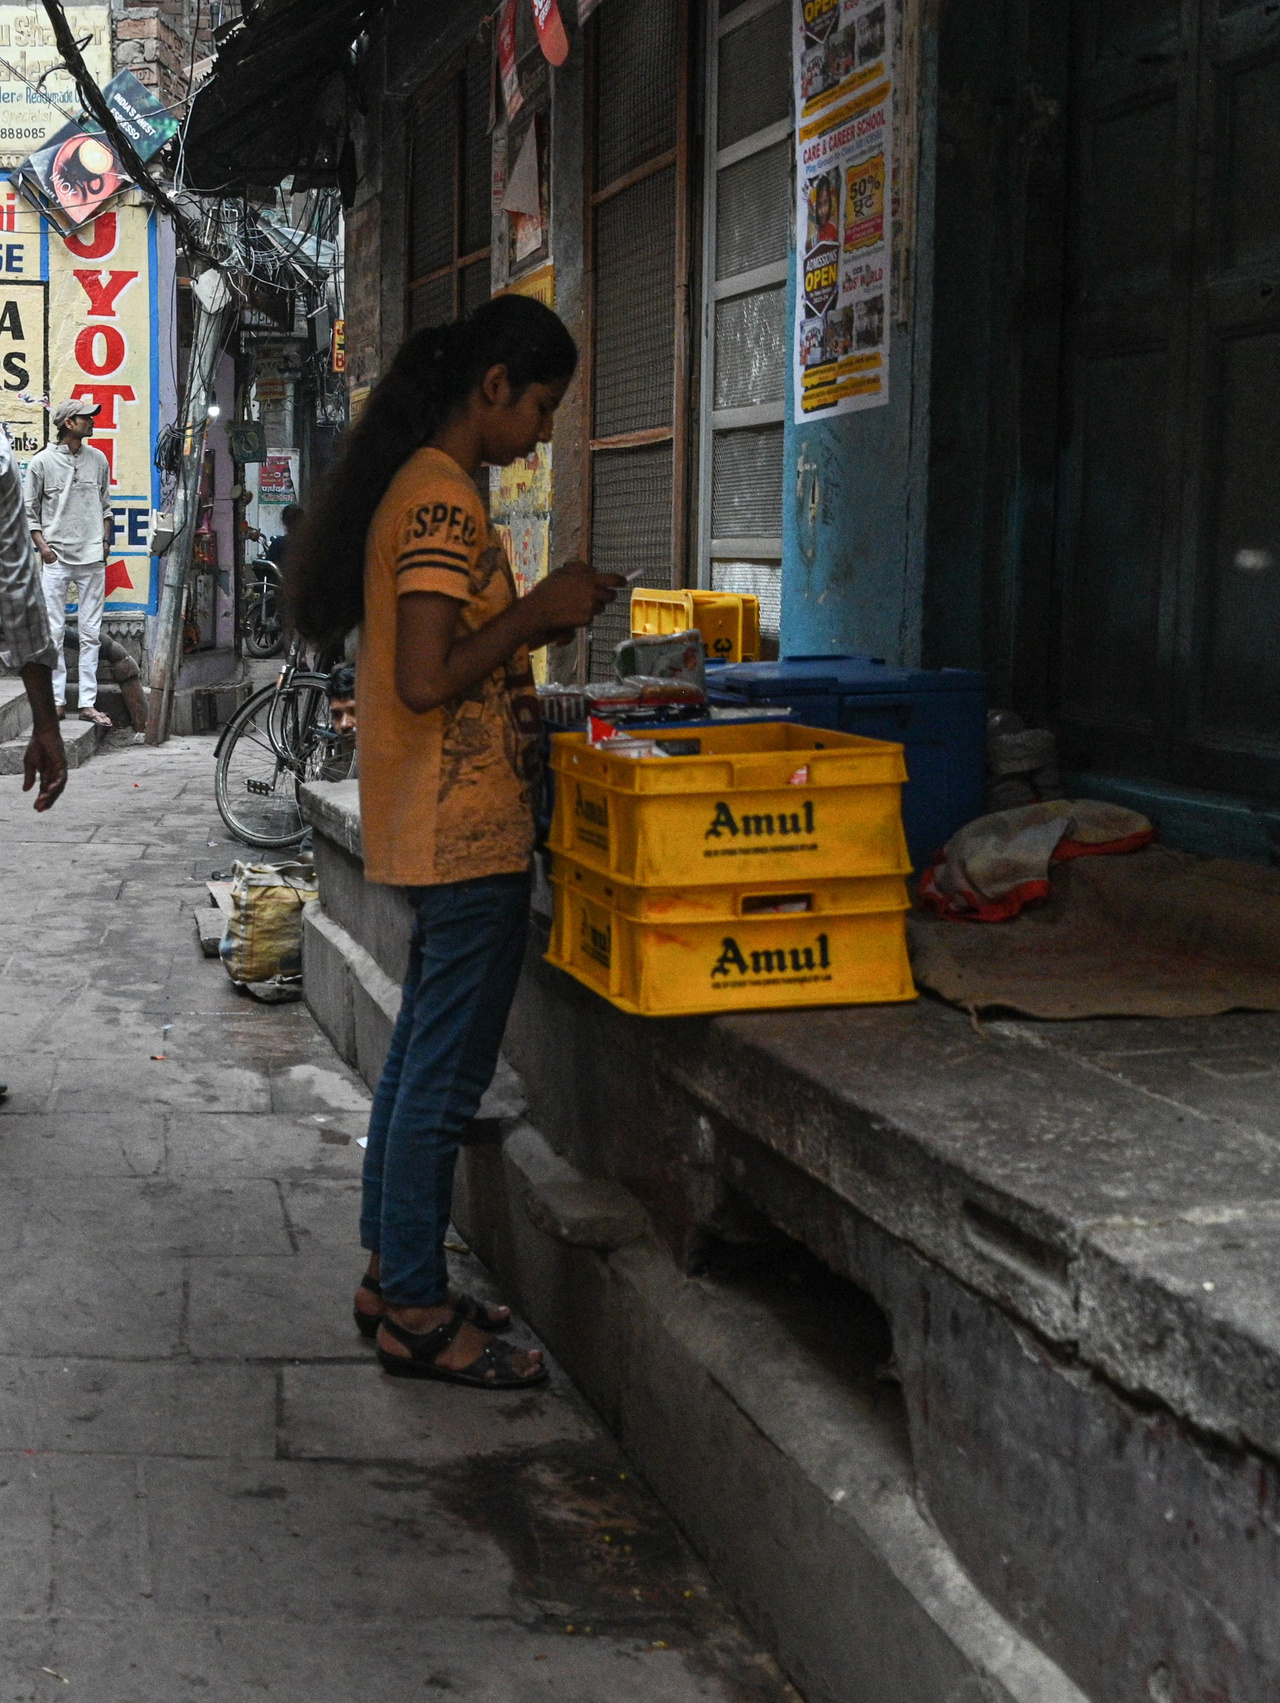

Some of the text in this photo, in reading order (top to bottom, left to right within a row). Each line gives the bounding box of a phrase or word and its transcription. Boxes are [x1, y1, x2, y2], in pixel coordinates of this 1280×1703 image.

[14, 14, 106, 47] Shakar
[2, 109, 53, 125] Specialist
[114, 93, 157, 136] INDIA'S FINEST
[803, 143, 820, 164] CARE
[822, 140, 827, 155] &
[829, 124, 855, 152] CAREER
[857, 109, 886, 137] SCHOOL
[850, 175, 880, 200] 50%
[807, 248, 838, 272] ADMISSIONS
[805, 262, 838, 292] OPEN
[705, 801, 814, 840] Amul
[711, 932, 830, 978] Amul
